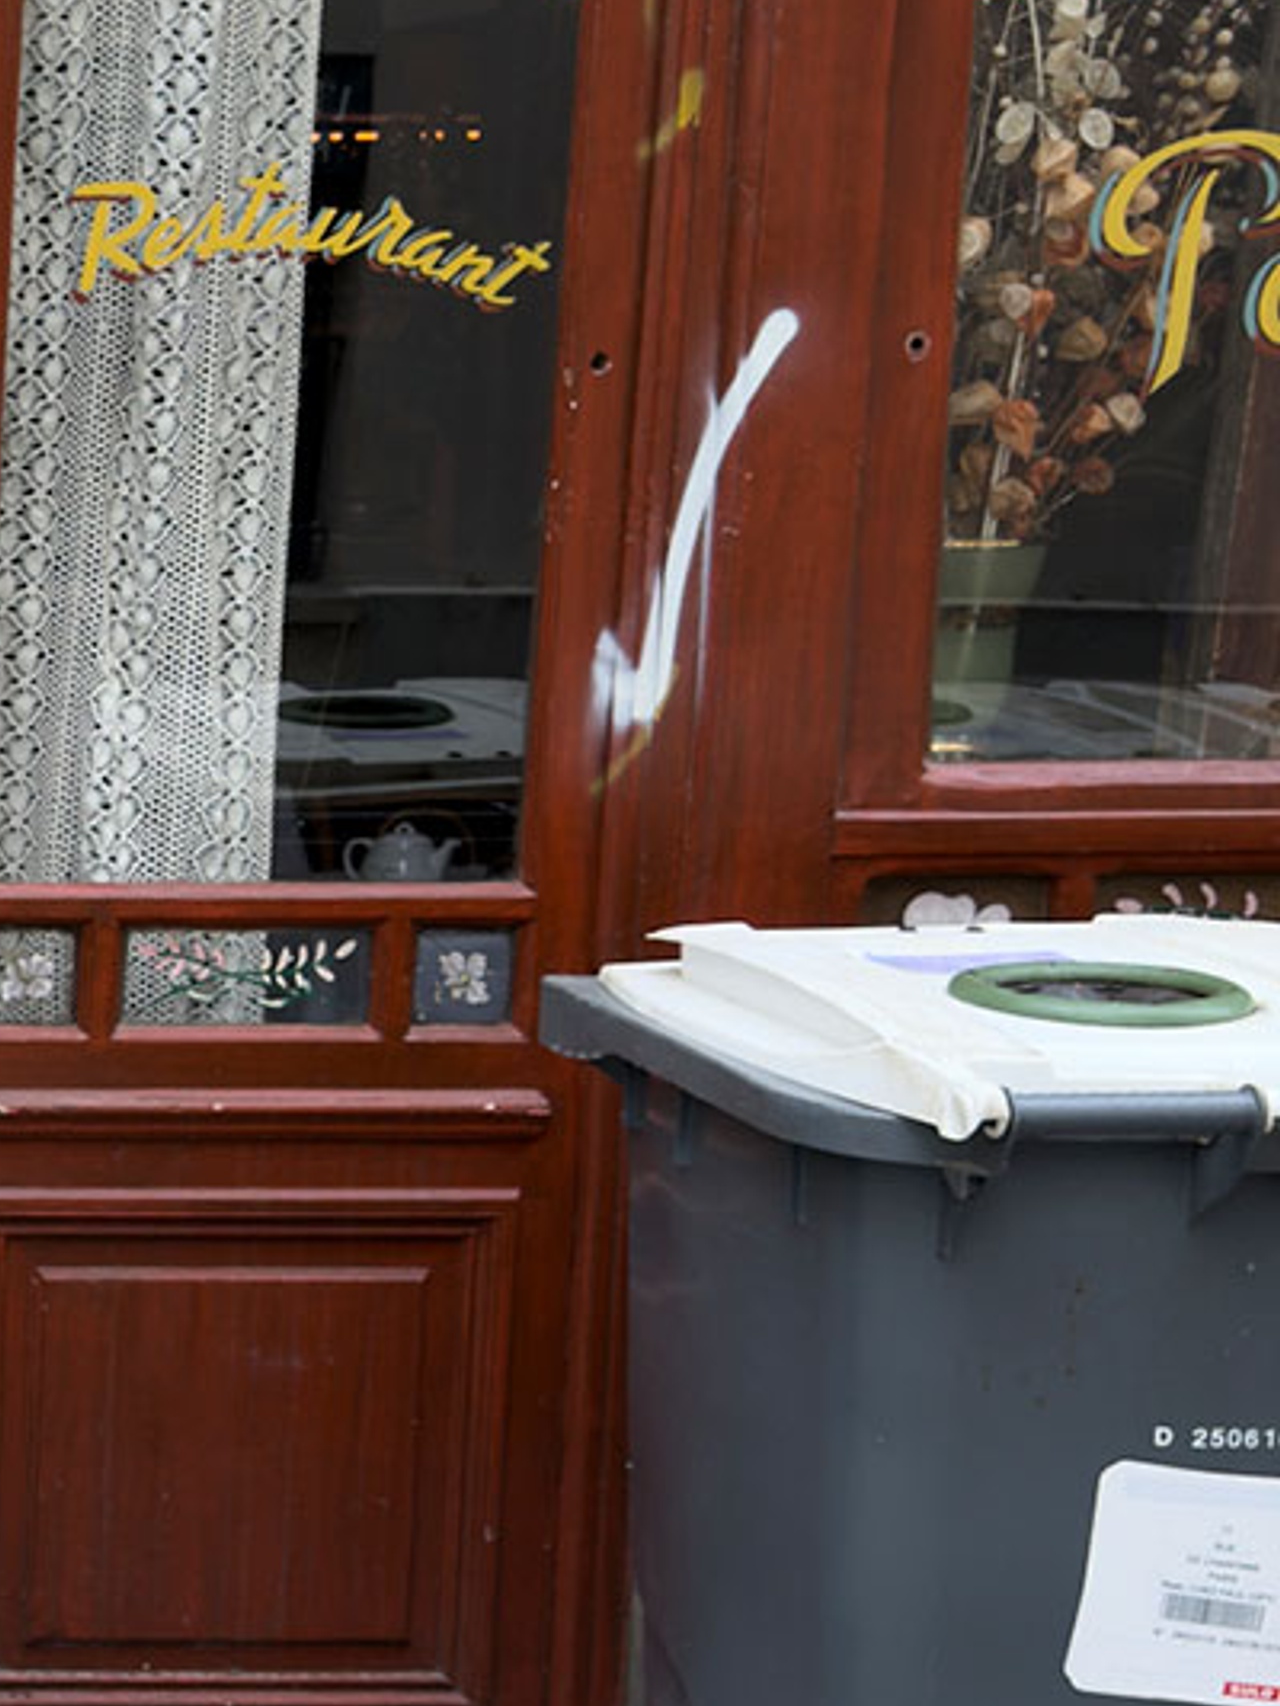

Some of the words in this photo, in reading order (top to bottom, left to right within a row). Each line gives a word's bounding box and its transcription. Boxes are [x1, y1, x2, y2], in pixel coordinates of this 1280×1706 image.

[68, 162, 552, 311] Restaurant
[1154, 1425, 1174, 1448] D
[1191, 1426, 1280, 1449] 25061
